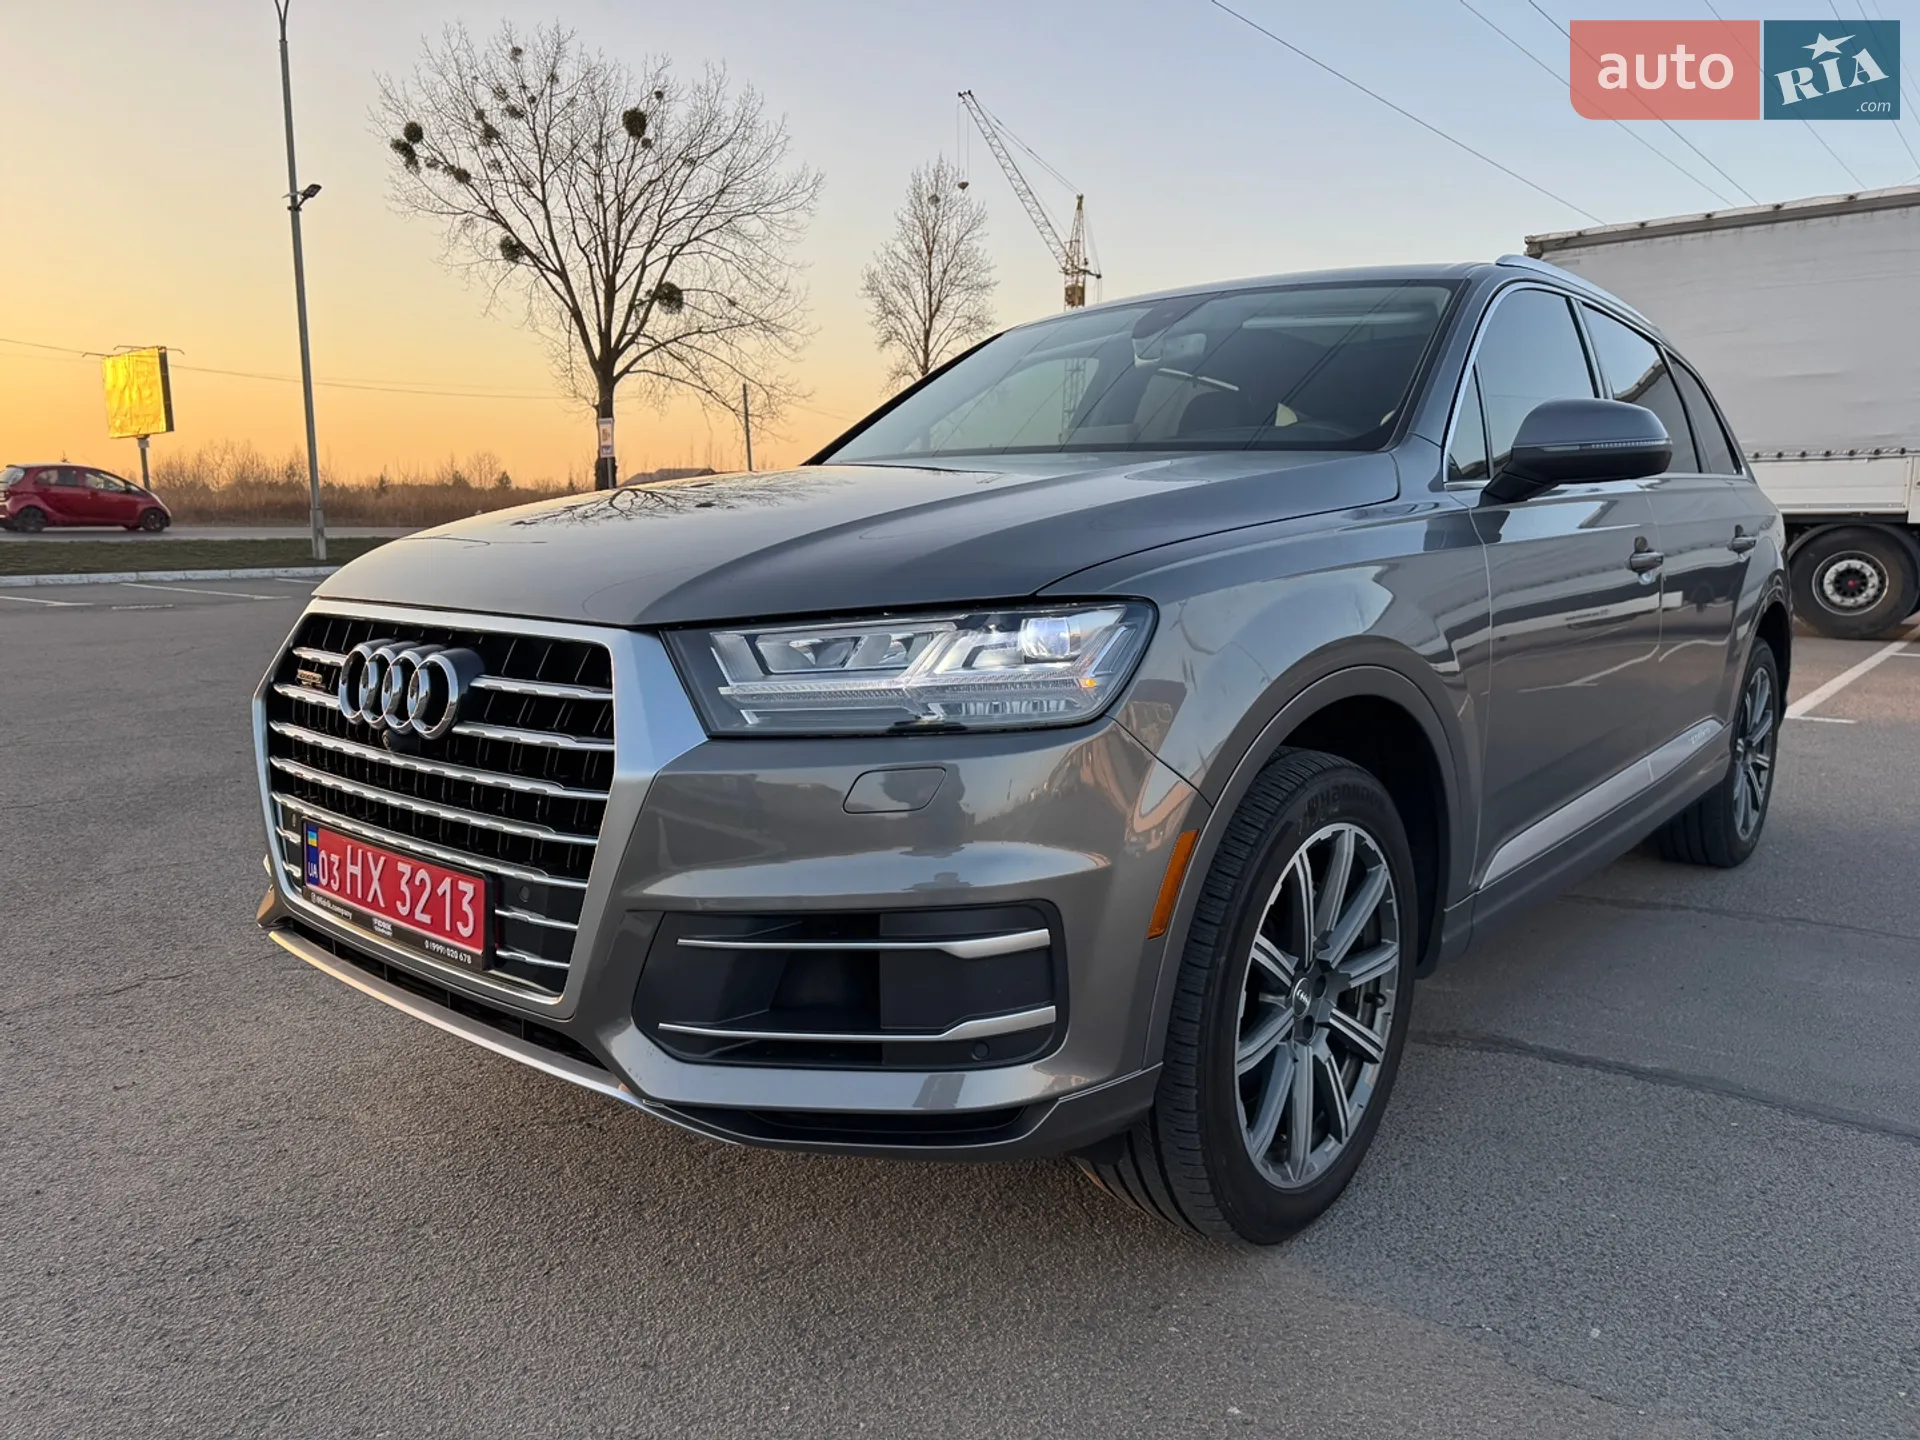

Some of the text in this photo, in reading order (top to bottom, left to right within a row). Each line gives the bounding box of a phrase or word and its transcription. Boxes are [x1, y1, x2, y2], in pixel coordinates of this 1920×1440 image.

[308, 861, 319, 879] UA
[319, 844, 475, 938] 03 HX 3213
